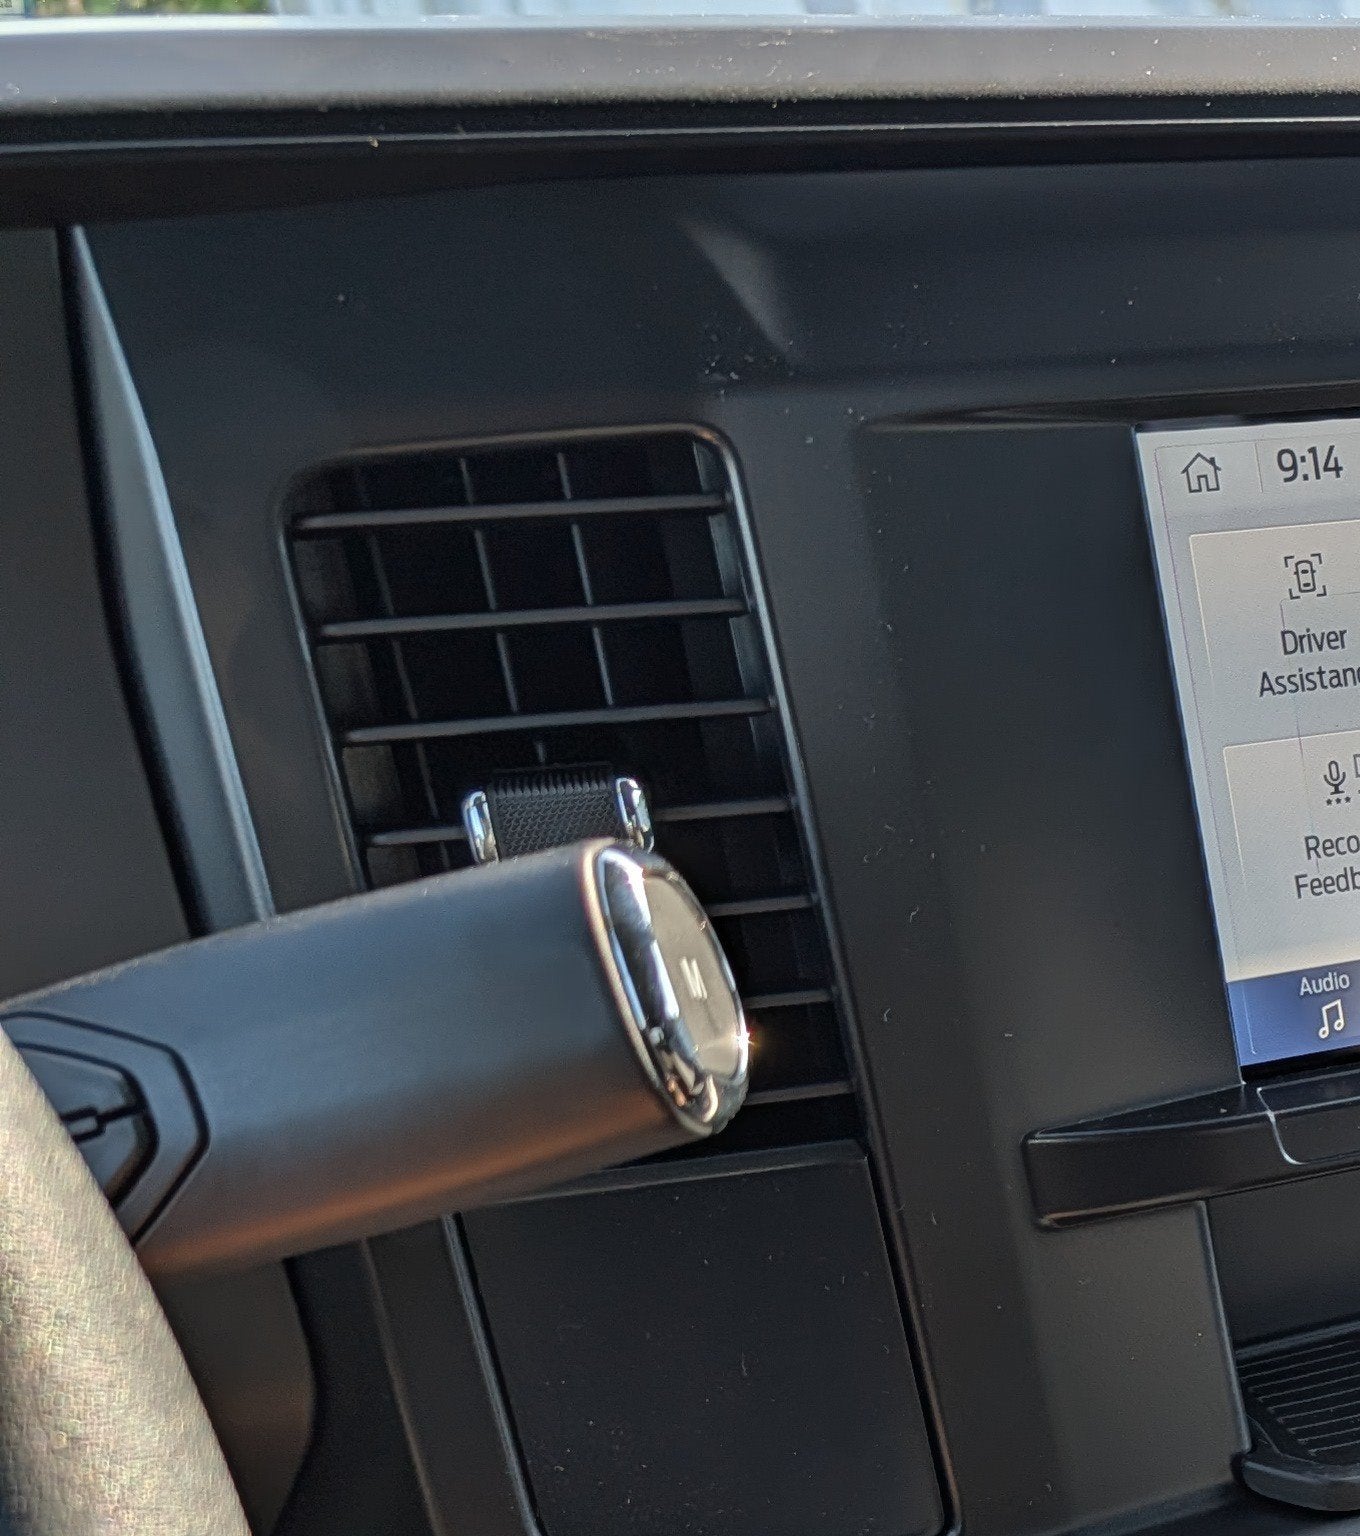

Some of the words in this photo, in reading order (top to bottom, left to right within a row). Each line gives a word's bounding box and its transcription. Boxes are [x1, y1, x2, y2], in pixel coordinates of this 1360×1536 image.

[1277, 445, 1343, 483] 9:14
[1281, 627, 1347, 655] Driver
[1300, 971, 1350, 996] Audio
